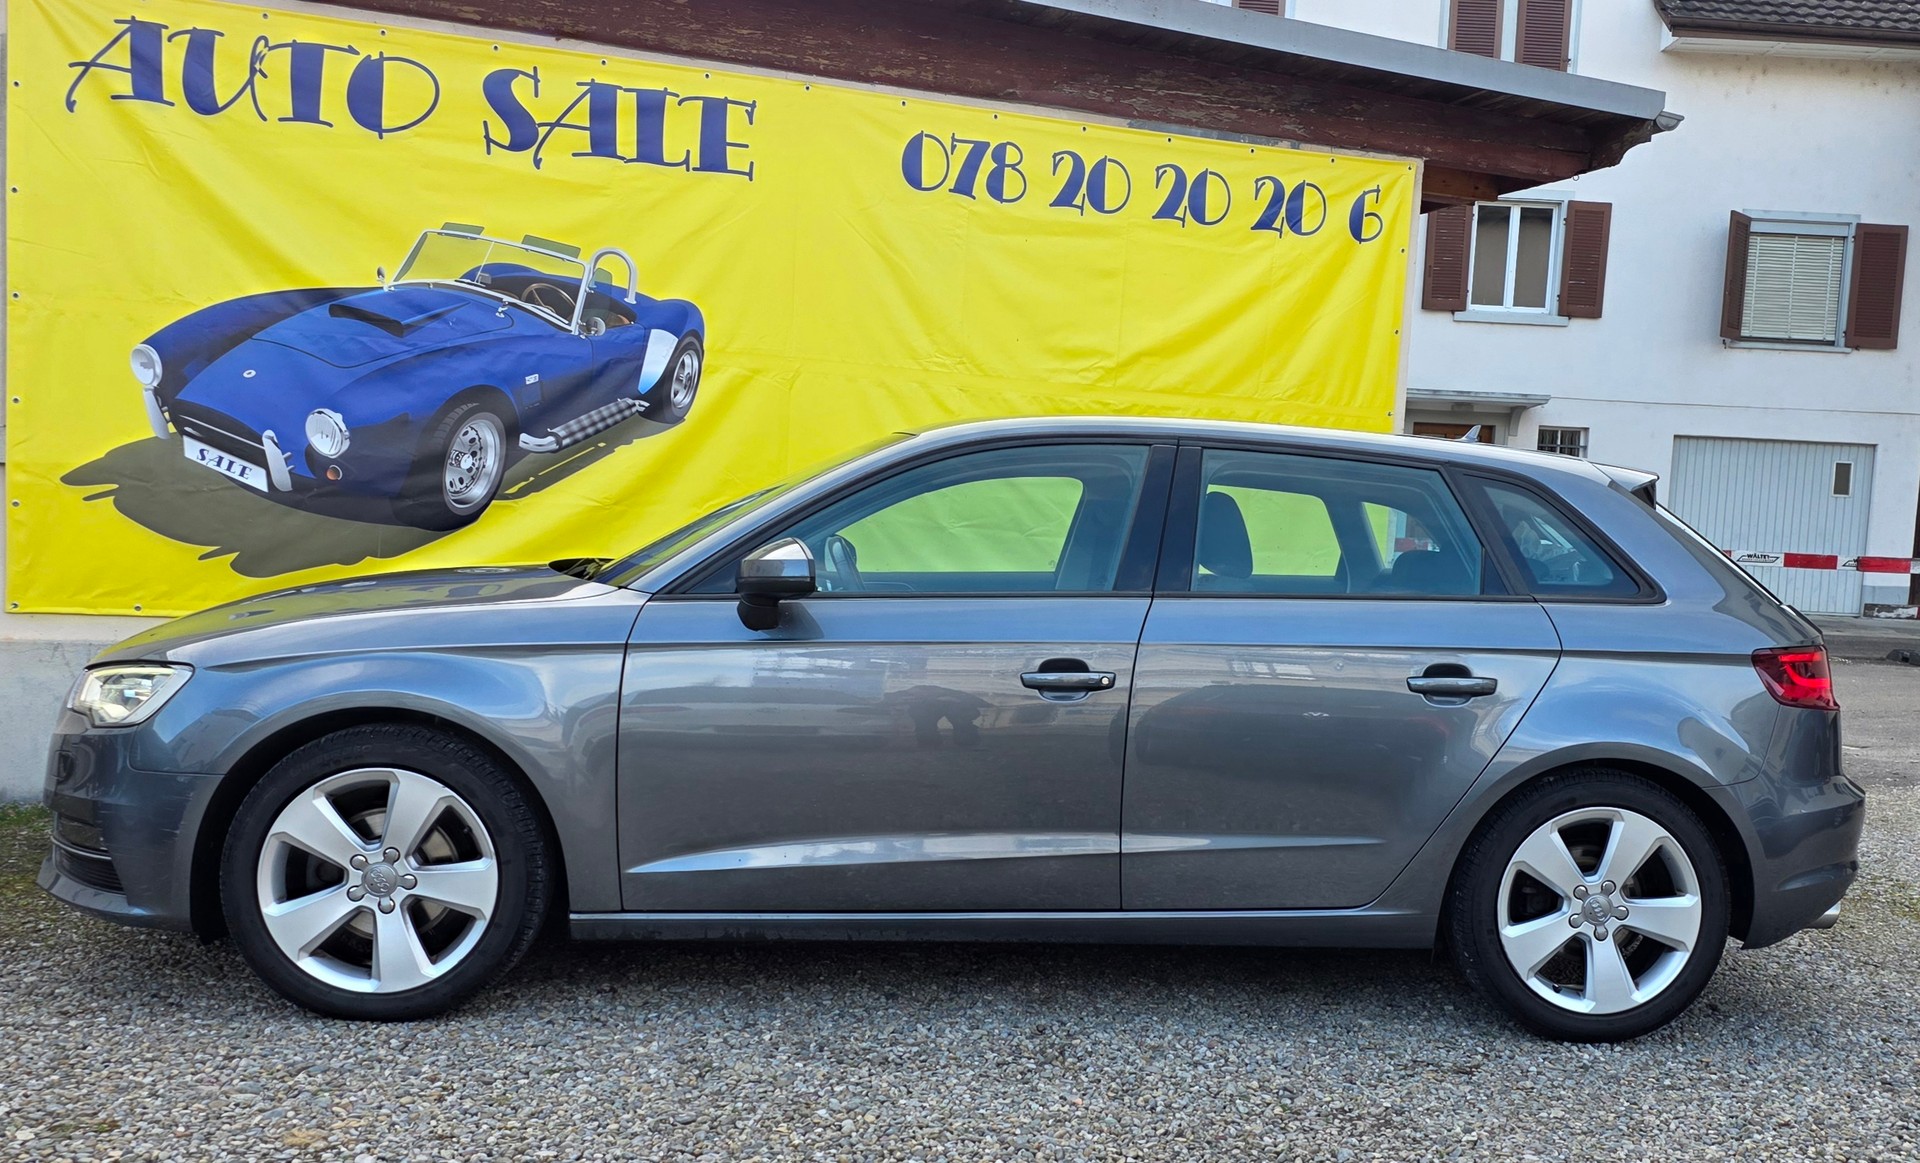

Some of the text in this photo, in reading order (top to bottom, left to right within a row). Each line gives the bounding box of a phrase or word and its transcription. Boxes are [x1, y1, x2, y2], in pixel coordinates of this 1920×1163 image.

[66, 16, 757, 182] AUTO SALE
[901, 130, 1384, 244] 078 20 20 20 6
[194, 447, 253, 480] SALE
